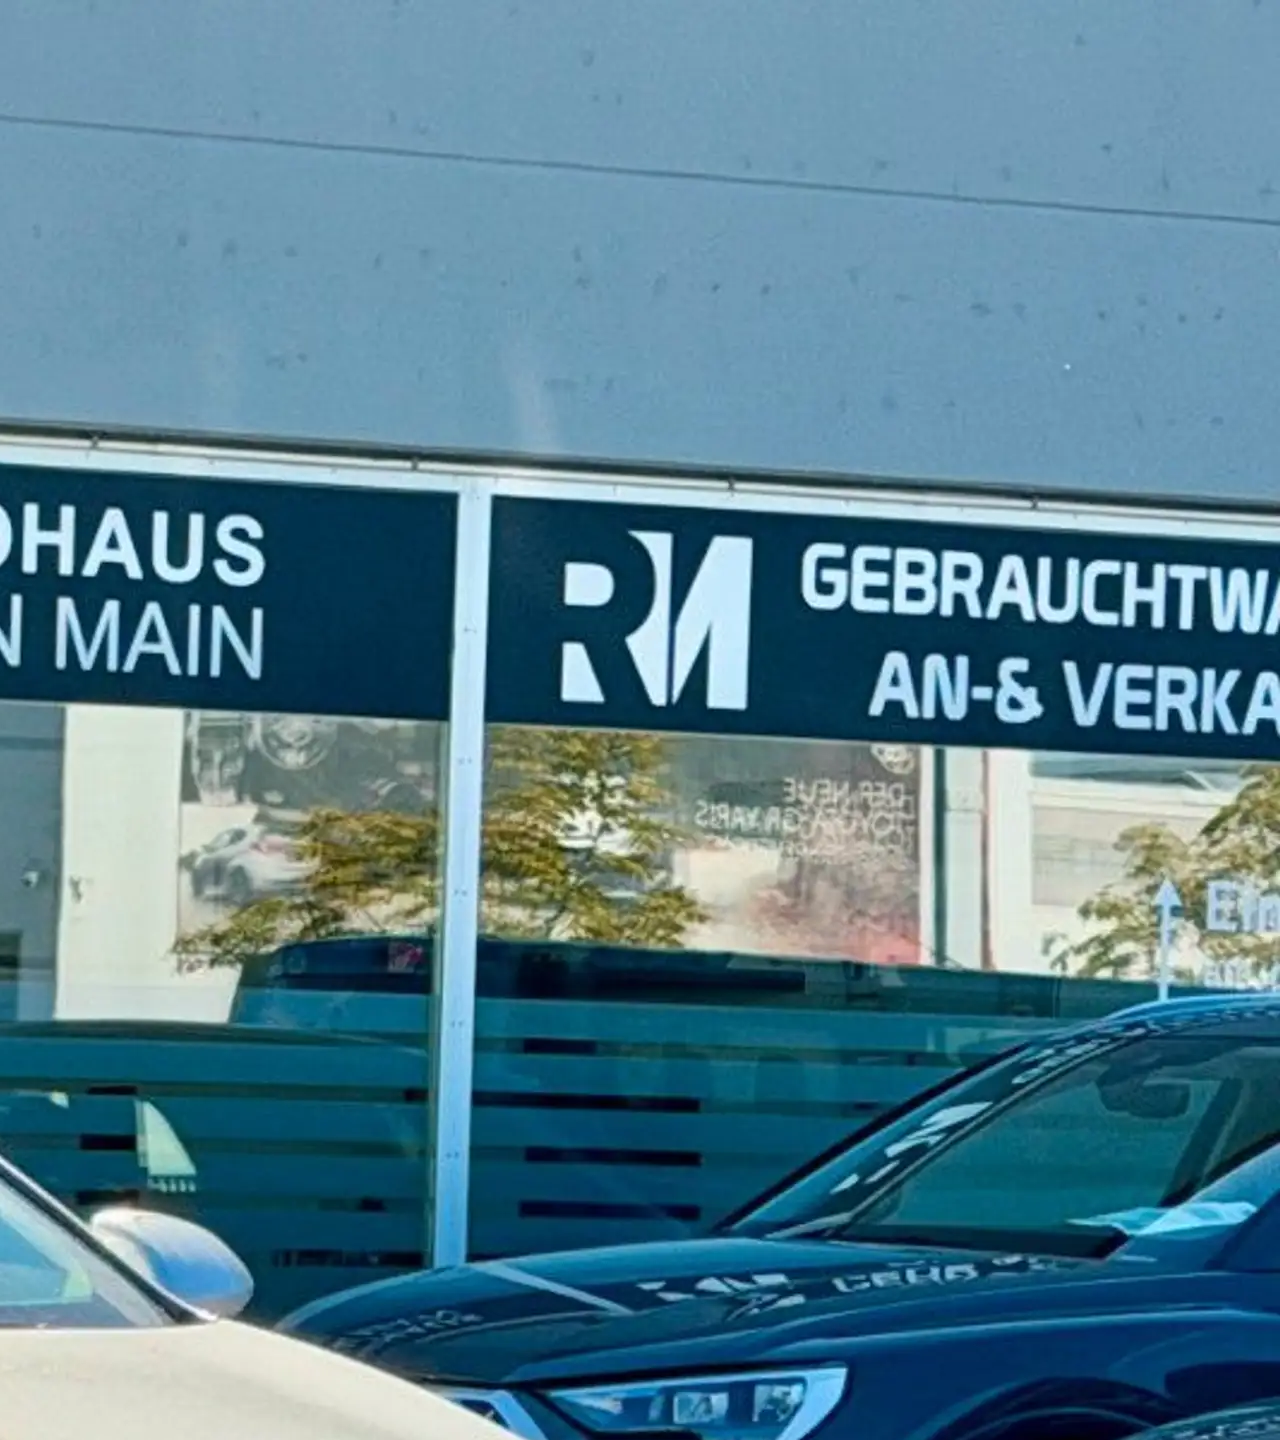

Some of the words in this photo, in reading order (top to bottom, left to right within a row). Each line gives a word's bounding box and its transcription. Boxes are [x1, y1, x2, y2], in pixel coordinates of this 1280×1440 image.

[54, 596, 266, 680] MAIN
[561, 529, 754, 711] RM
[868, 650, 1045, 724] AN-&
